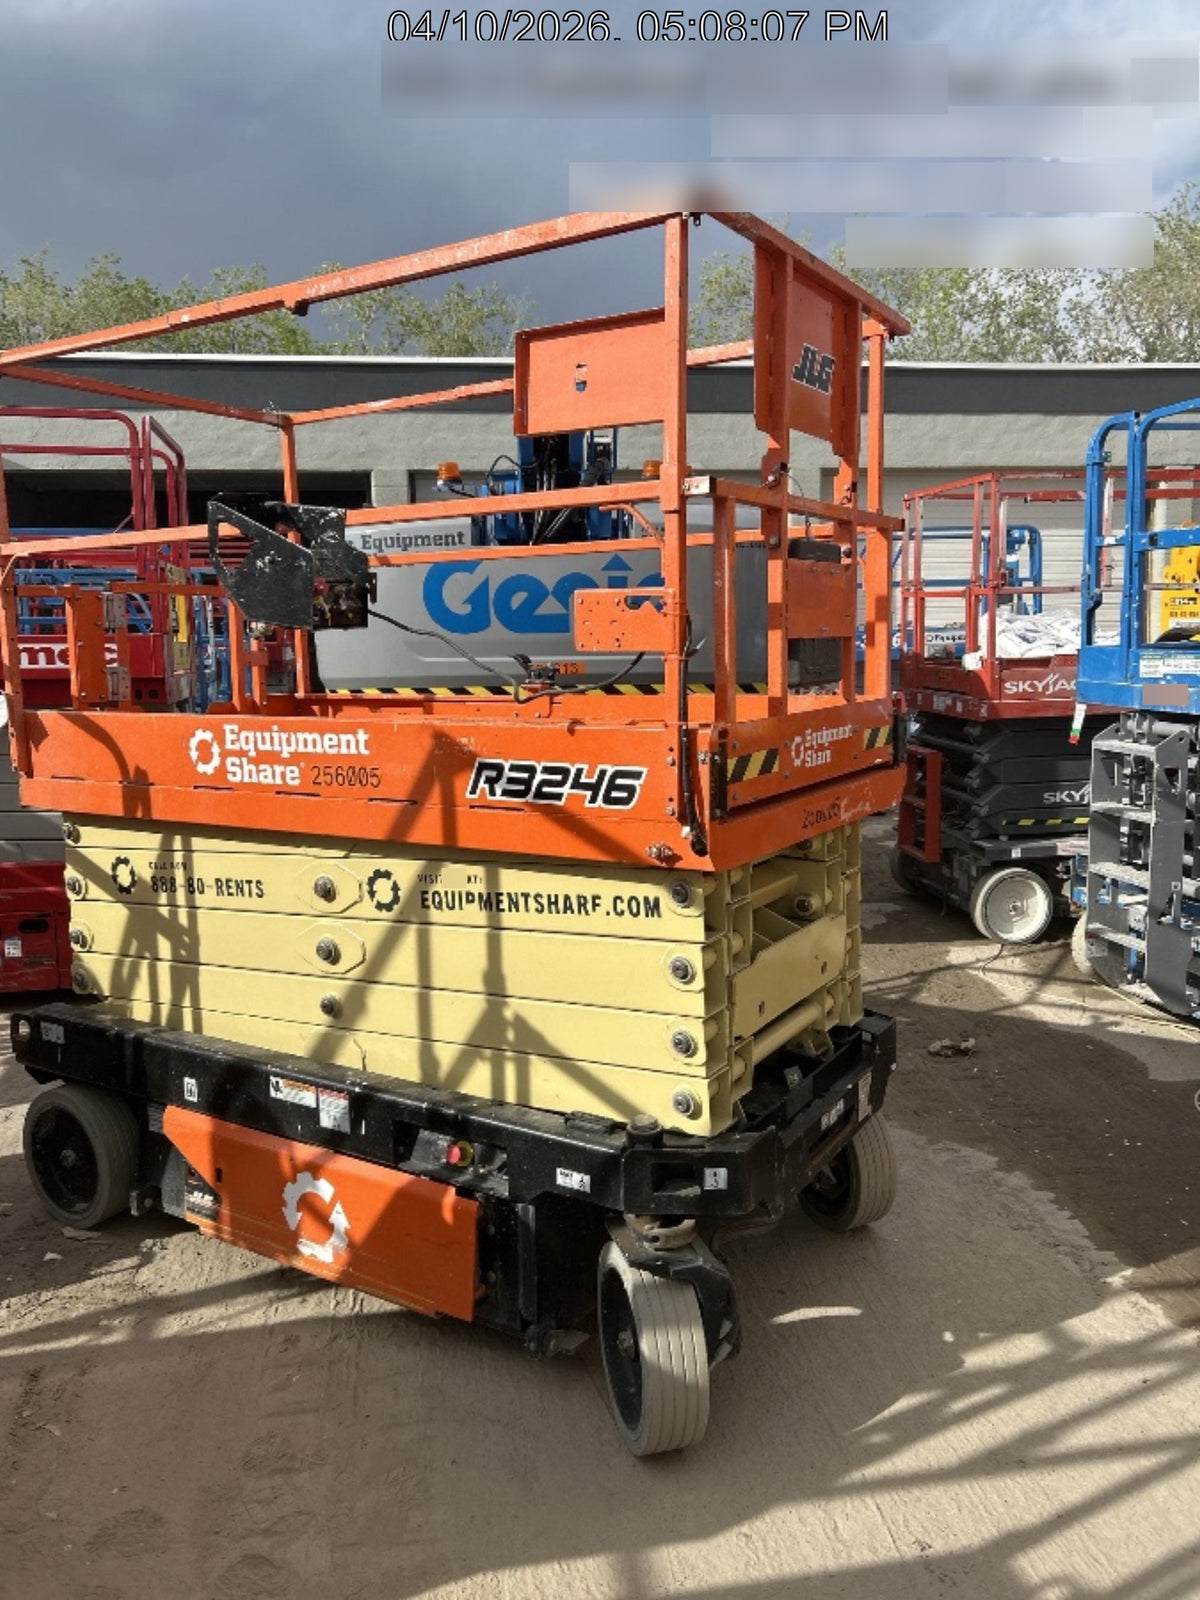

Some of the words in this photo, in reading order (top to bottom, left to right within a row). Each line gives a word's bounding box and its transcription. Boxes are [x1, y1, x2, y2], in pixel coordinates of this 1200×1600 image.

[360, 531, 465, 553] Equipment
[223, 724, 370, 758] Equipment
[225, 756, 300, 786] Share
[310, 765, 381, 788] 256005
[465, 757, 649, 810] R3246
[150, 875, 264, 899] 888-80-RENTS
